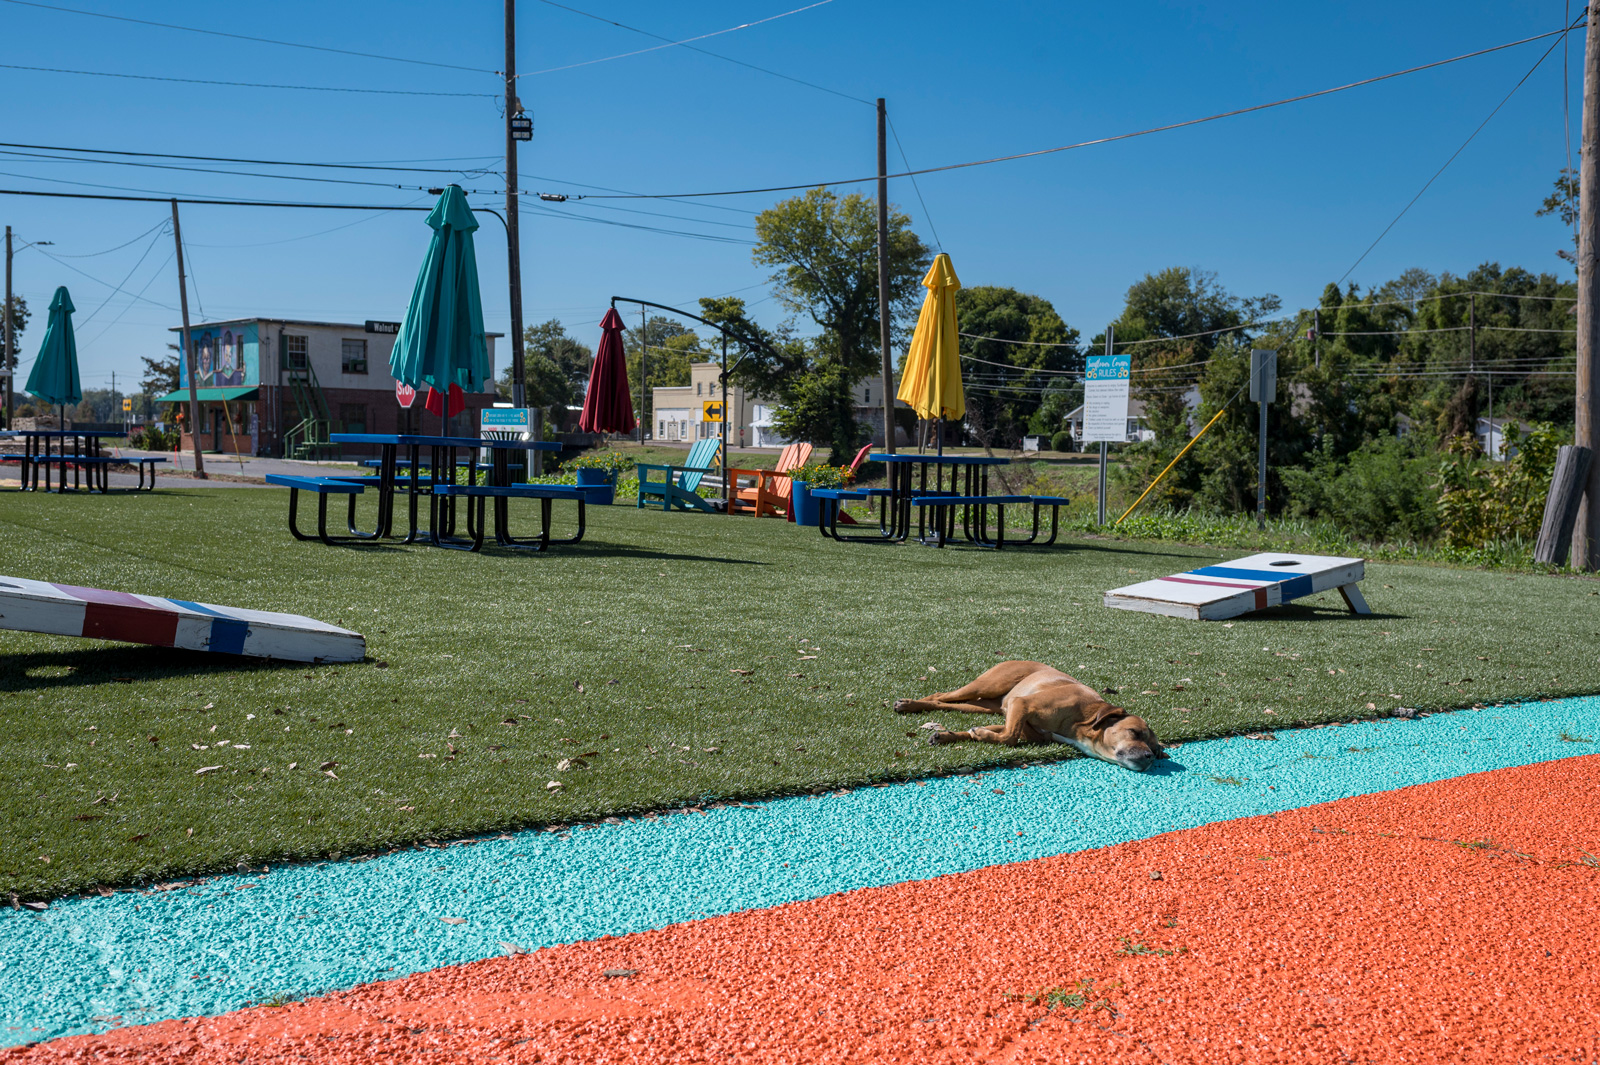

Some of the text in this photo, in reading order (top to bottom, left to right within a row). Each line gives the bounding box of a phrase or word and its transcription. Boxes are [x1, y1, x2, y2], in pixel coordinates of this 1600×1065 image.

[373, 322, 394, 333] Walnut
[1088, 358, 1110, 371] Sunflower
[1098, 368, 1117, 377] RULES
